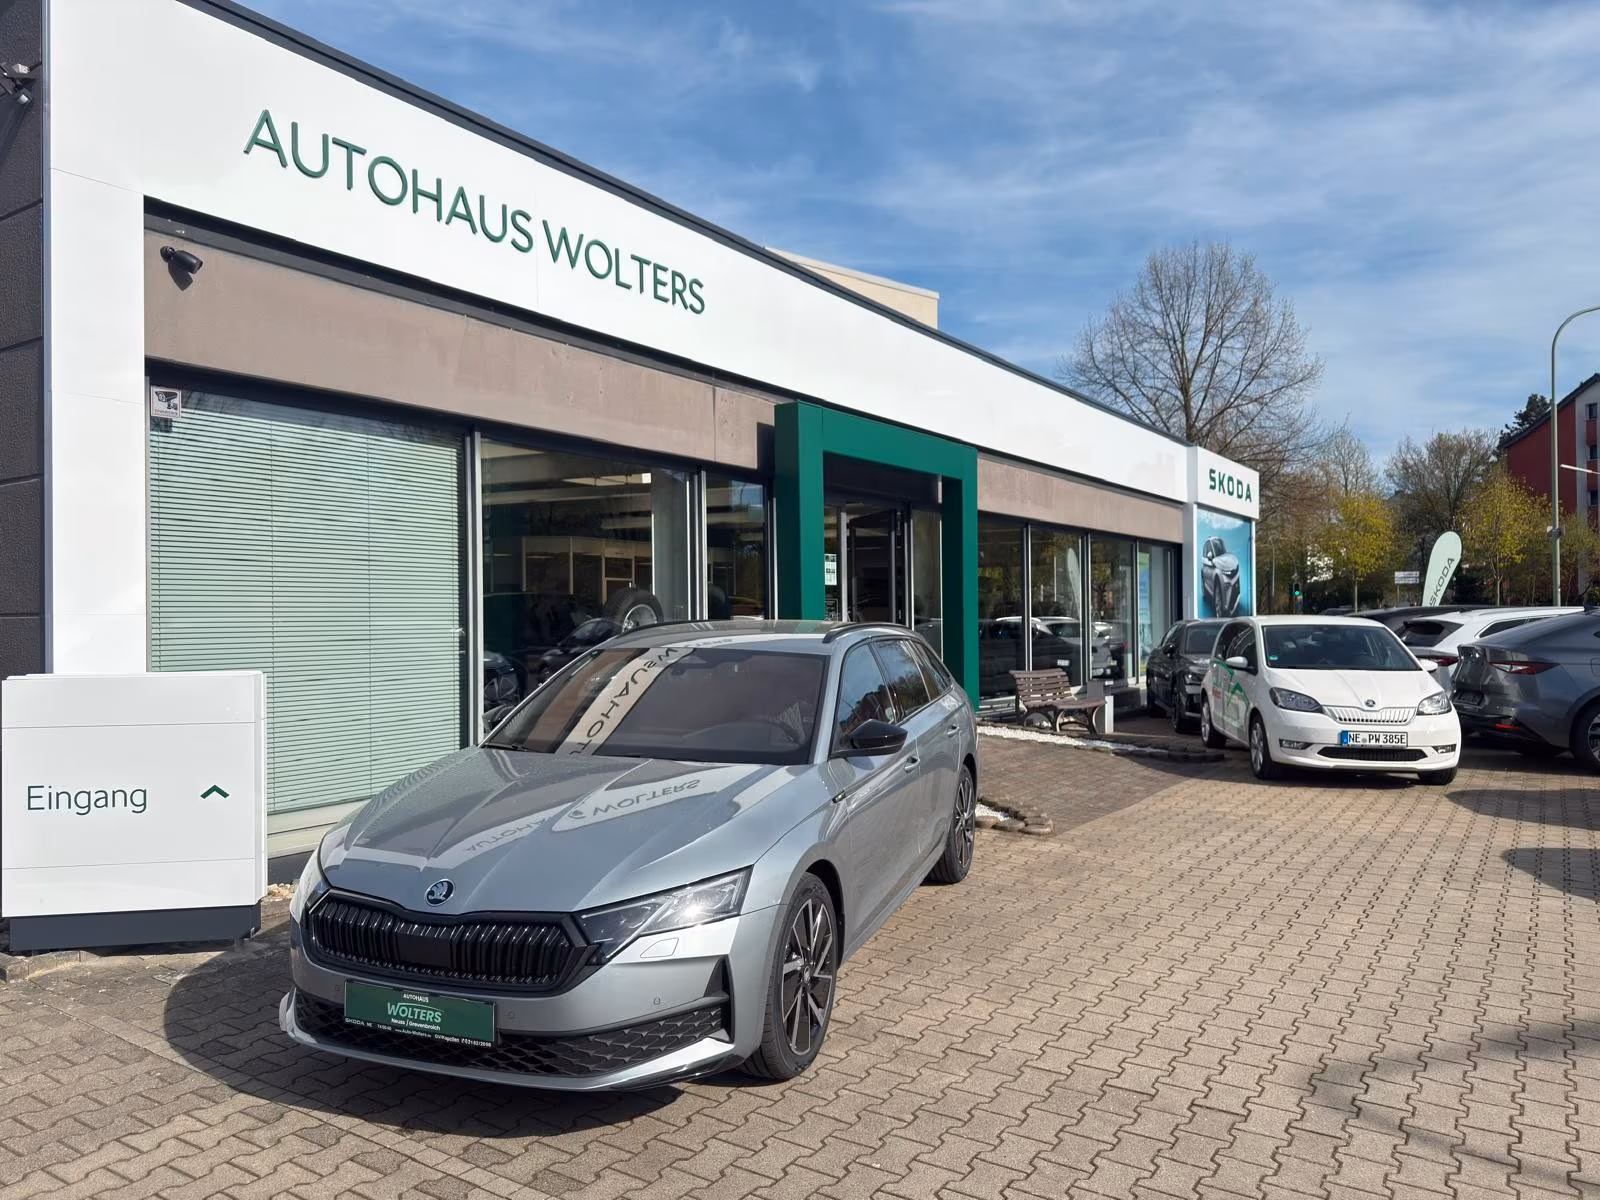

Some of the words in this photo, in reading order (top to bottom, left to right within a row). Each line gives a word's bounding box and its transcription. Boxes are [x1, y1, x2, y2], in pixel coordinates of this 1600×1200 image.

[243, 109, 533, 253] AUTOHAUS
[542, 219, 706, 315] WOLTERS
[1348, 733, 1361, 744] NE
[1368, 733, 1381, 744] PW
[1382, 733, 1406, 744] 385E
[27, 785, 147, 816] Eingang
[402, 993, 429, 1003] AUTOHAUS
[387, 1002, 442, 1023] WOLTERS
